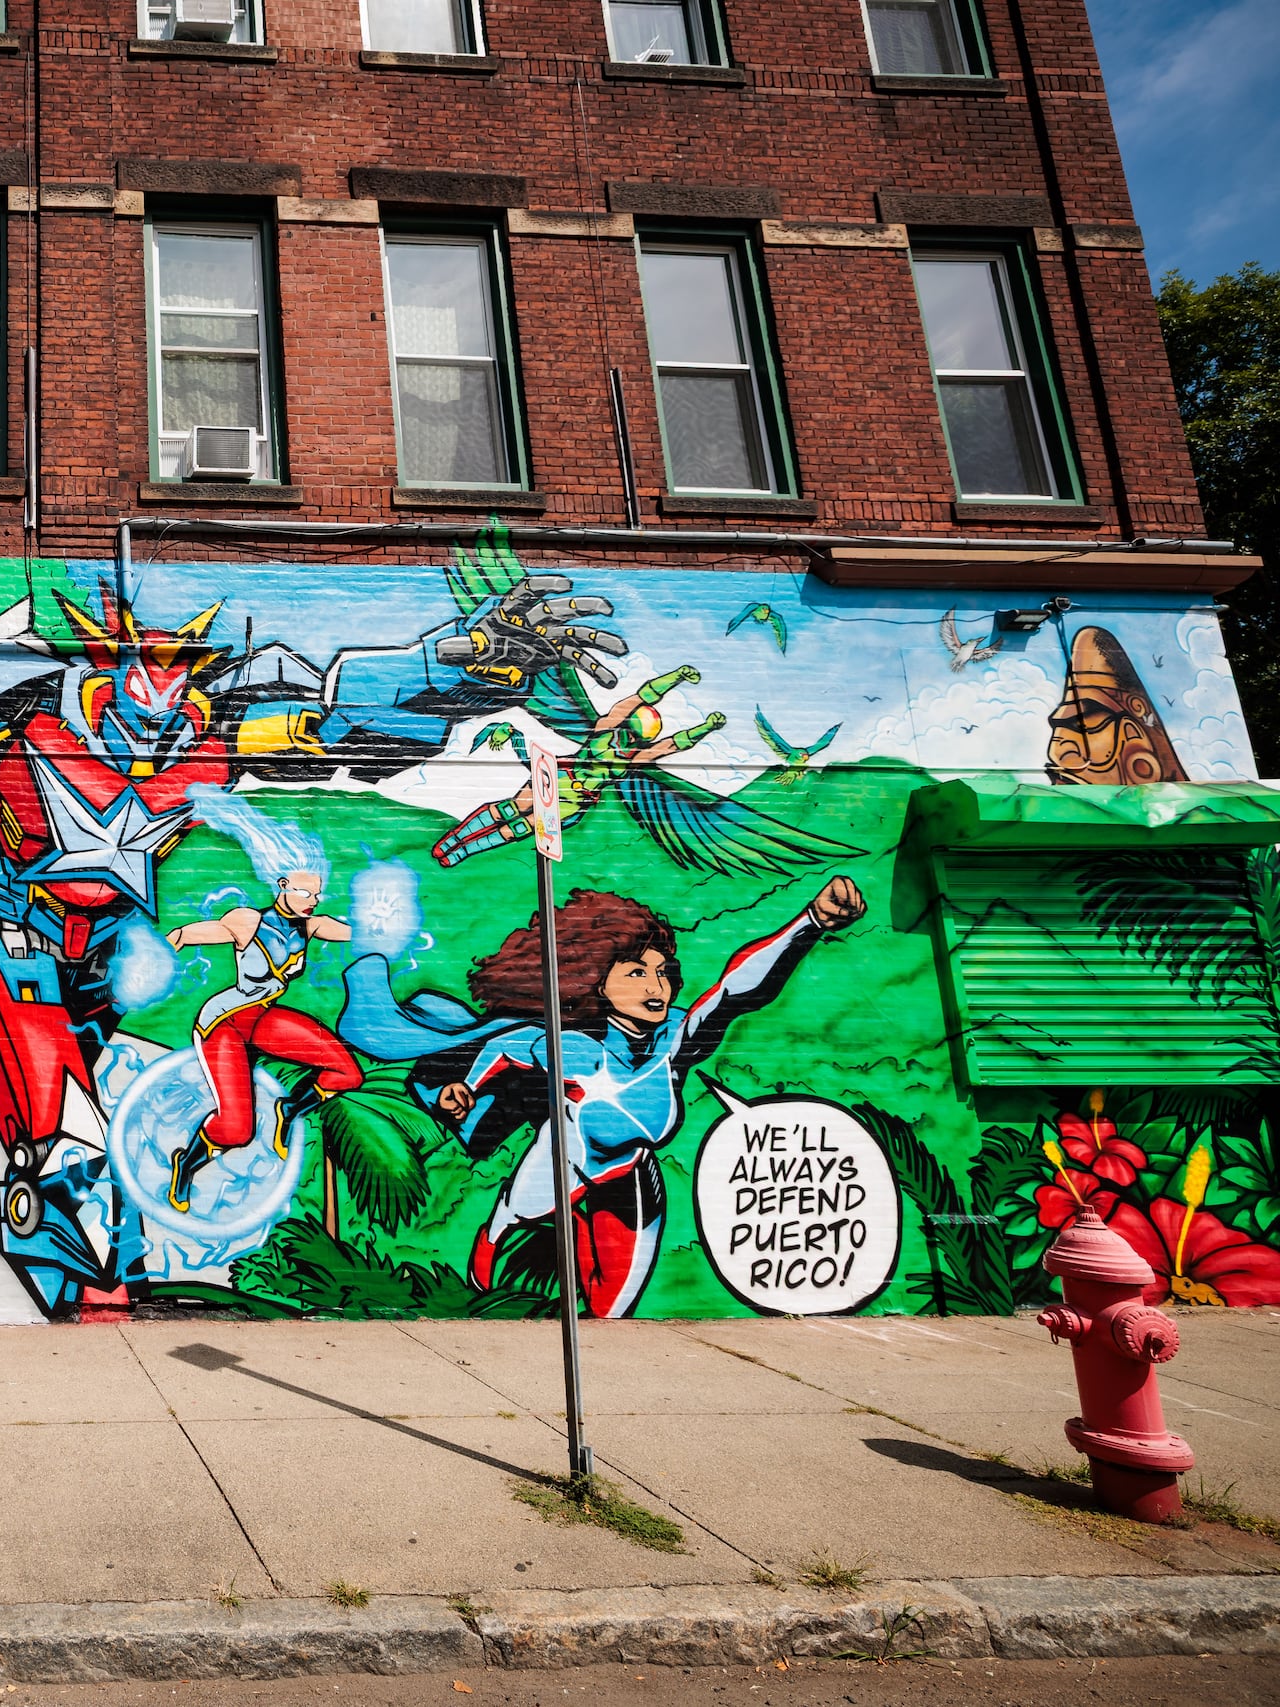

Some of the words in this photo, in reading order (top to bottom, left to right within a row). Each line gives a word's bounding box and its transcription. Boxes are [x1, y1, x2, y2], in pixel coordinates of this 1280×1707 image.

[743, 1123, 839, 1153] WE'LL
[729, 1155, 859, 1184] ALWAYS
[735, 1182, 866, 1216] DEFEND
[730, 1218, 867, 1255] PUERTO
[750, 1251, 855, 1289] RICO!
